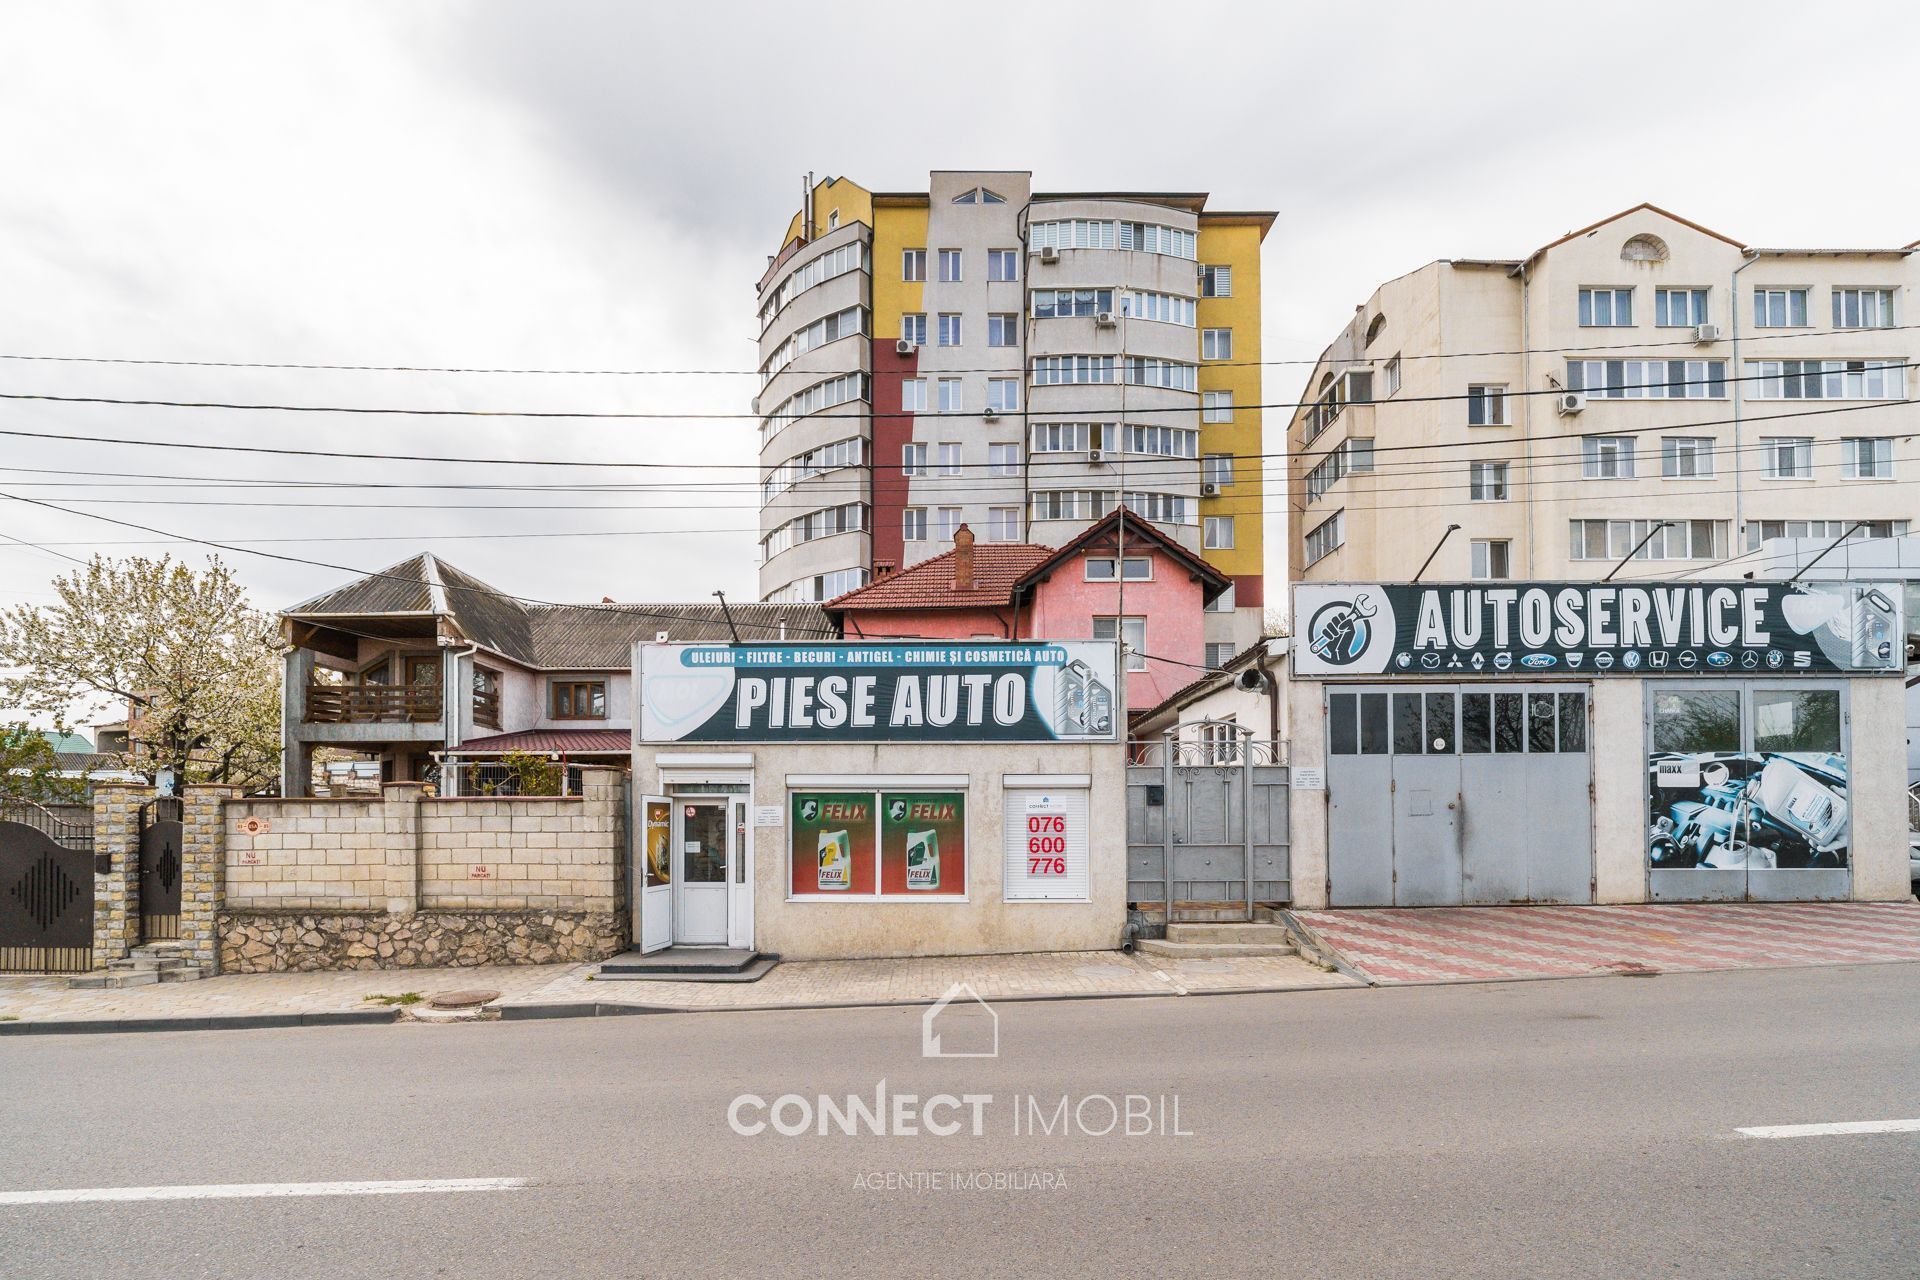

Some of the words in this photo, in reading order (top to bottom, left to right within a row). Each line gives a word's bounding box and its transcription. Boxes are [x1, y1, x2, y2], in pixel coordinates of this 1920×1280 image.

[1414, 588, 1770, 649] AUTOSERVICE
[691, 651, 735, 664] ULEIURI
[747, 651, 783, 663] FILTRE
[794, 651, 835, 663] BECURI
[847, 651, 893, 663] ANTIGEL
[905, 651, 946, 662] CHIMIE
[965, 648, 1031, 662] COSMETICĂ
[1034, 650, 1065, 662] AUTO
[1528, 655, 1550, 665] Ford
[735, 675, 877, 729] PIESE
[889, 672, 1026, 727] AUTO
[1659, 765, 1682, 774] maxx
[821, 803, 867, 821] FELIX
[909, 803, 955, 821] FELIX
[1028, 816, 1065, 833] 076
[1029, 837, 1065, 853] 600
[1028, 857, 1066, 874] 776
[821, 871, 842, 879] FELIX
[910, 871, 931, 879] FELIX
